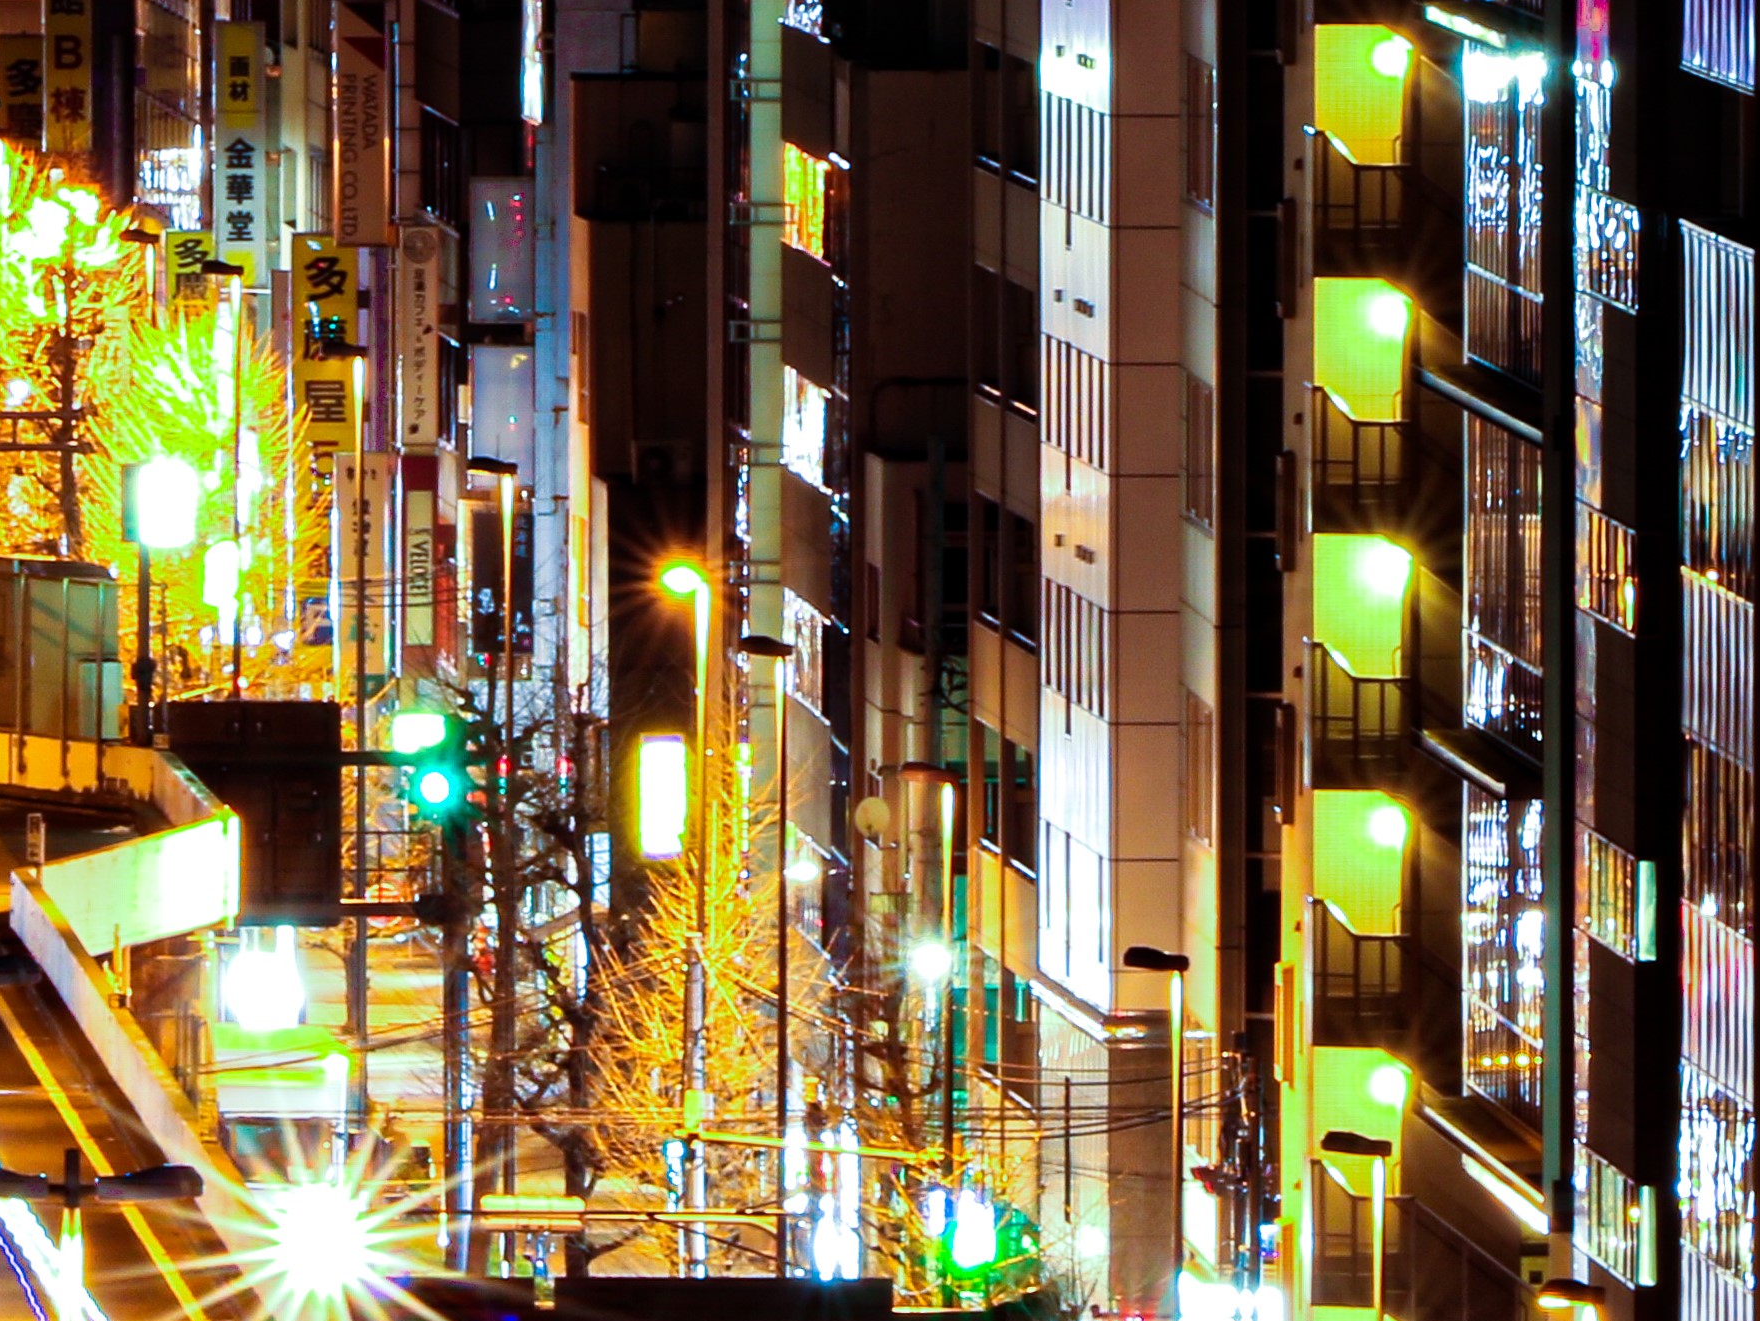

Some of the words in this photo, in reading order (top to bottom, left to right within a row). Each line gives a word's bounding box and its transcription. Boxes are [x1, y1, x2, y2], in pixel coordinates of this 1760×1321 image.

[228, 55, 250, 102] 画材
[342, 73, 356, 164] PRINTING
[363, 74, 377, 150] WATADA
[225, 137, 255, 243] 金華堂
